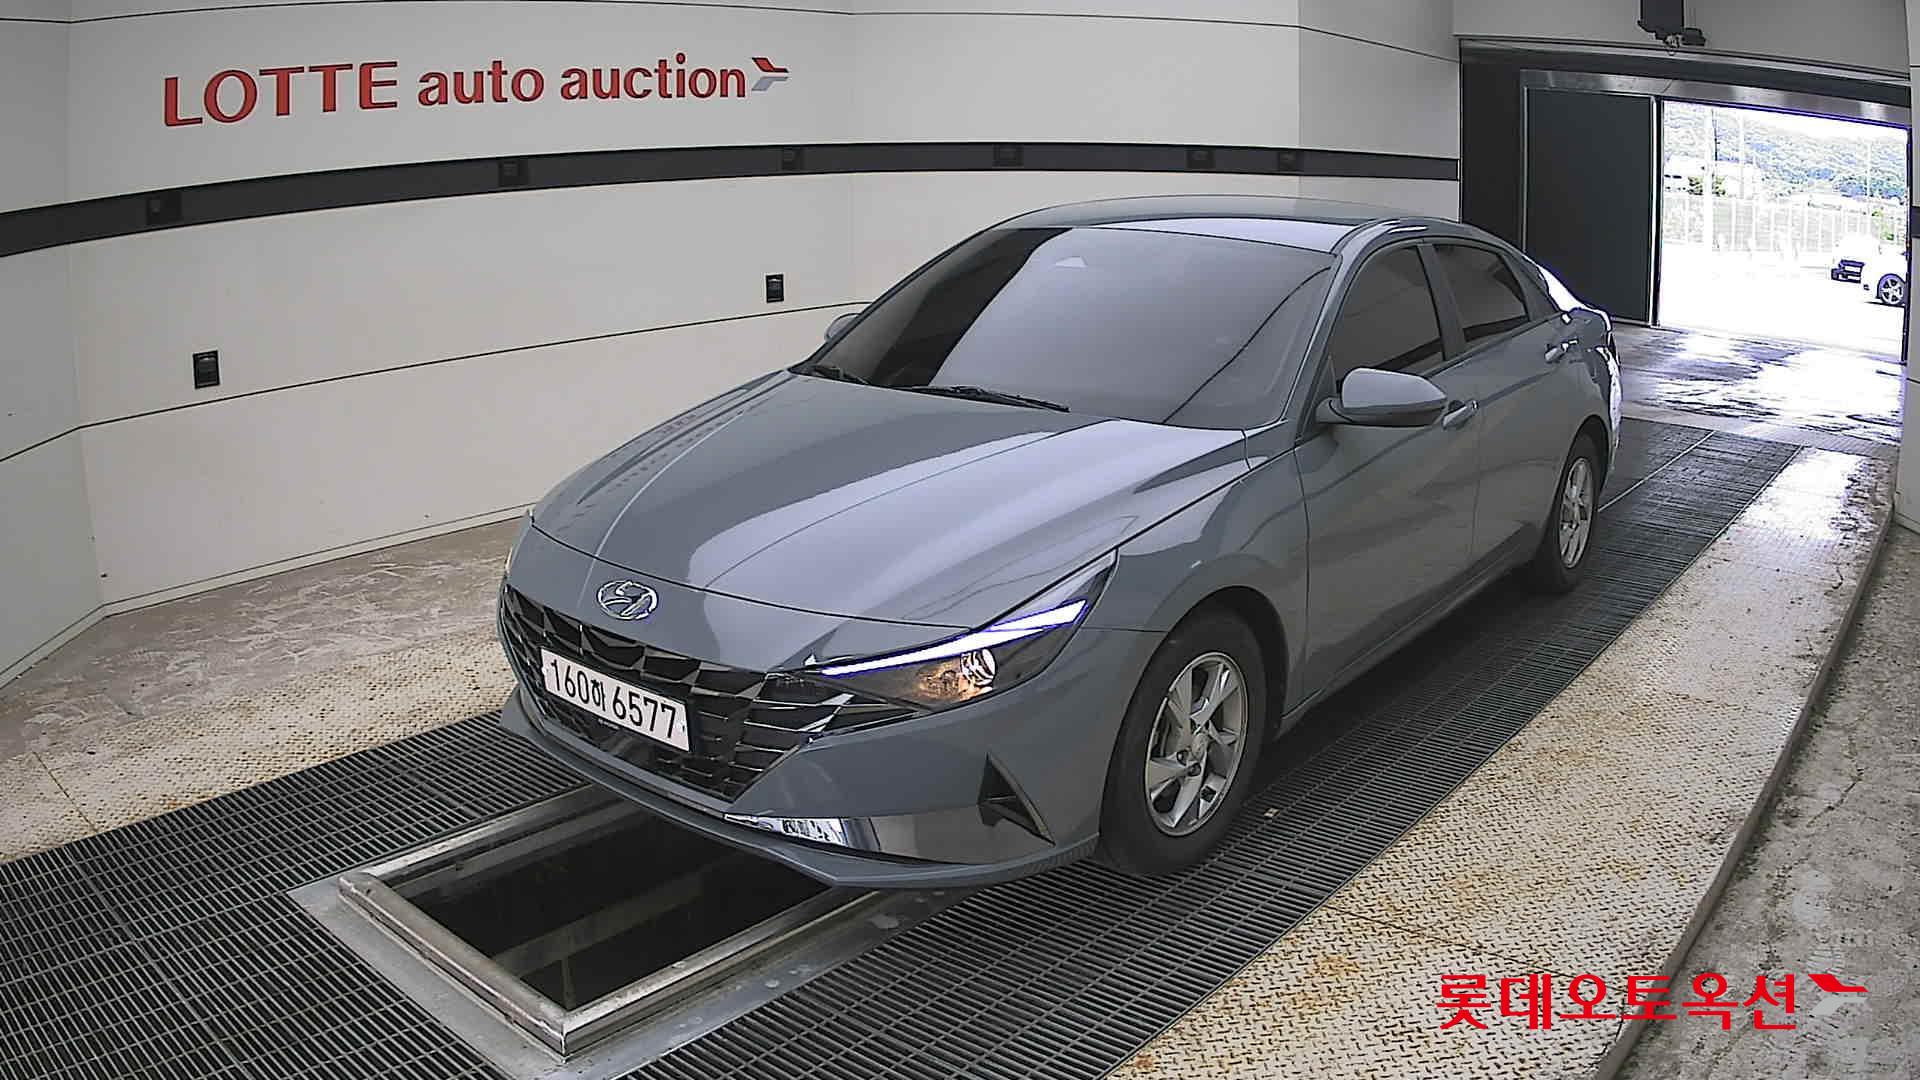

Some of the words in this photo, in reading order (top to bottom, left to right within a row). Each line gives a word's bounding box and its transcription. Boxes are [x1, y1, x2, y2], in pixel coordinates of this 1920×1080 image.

[163, 60, 398, 127] LOTTE
[417, 59, 545, 106] auto
[560, 52, 747, 100] auction
[550, 658, 607, 713] 160하
[612, 685, 677, 739] 6577
